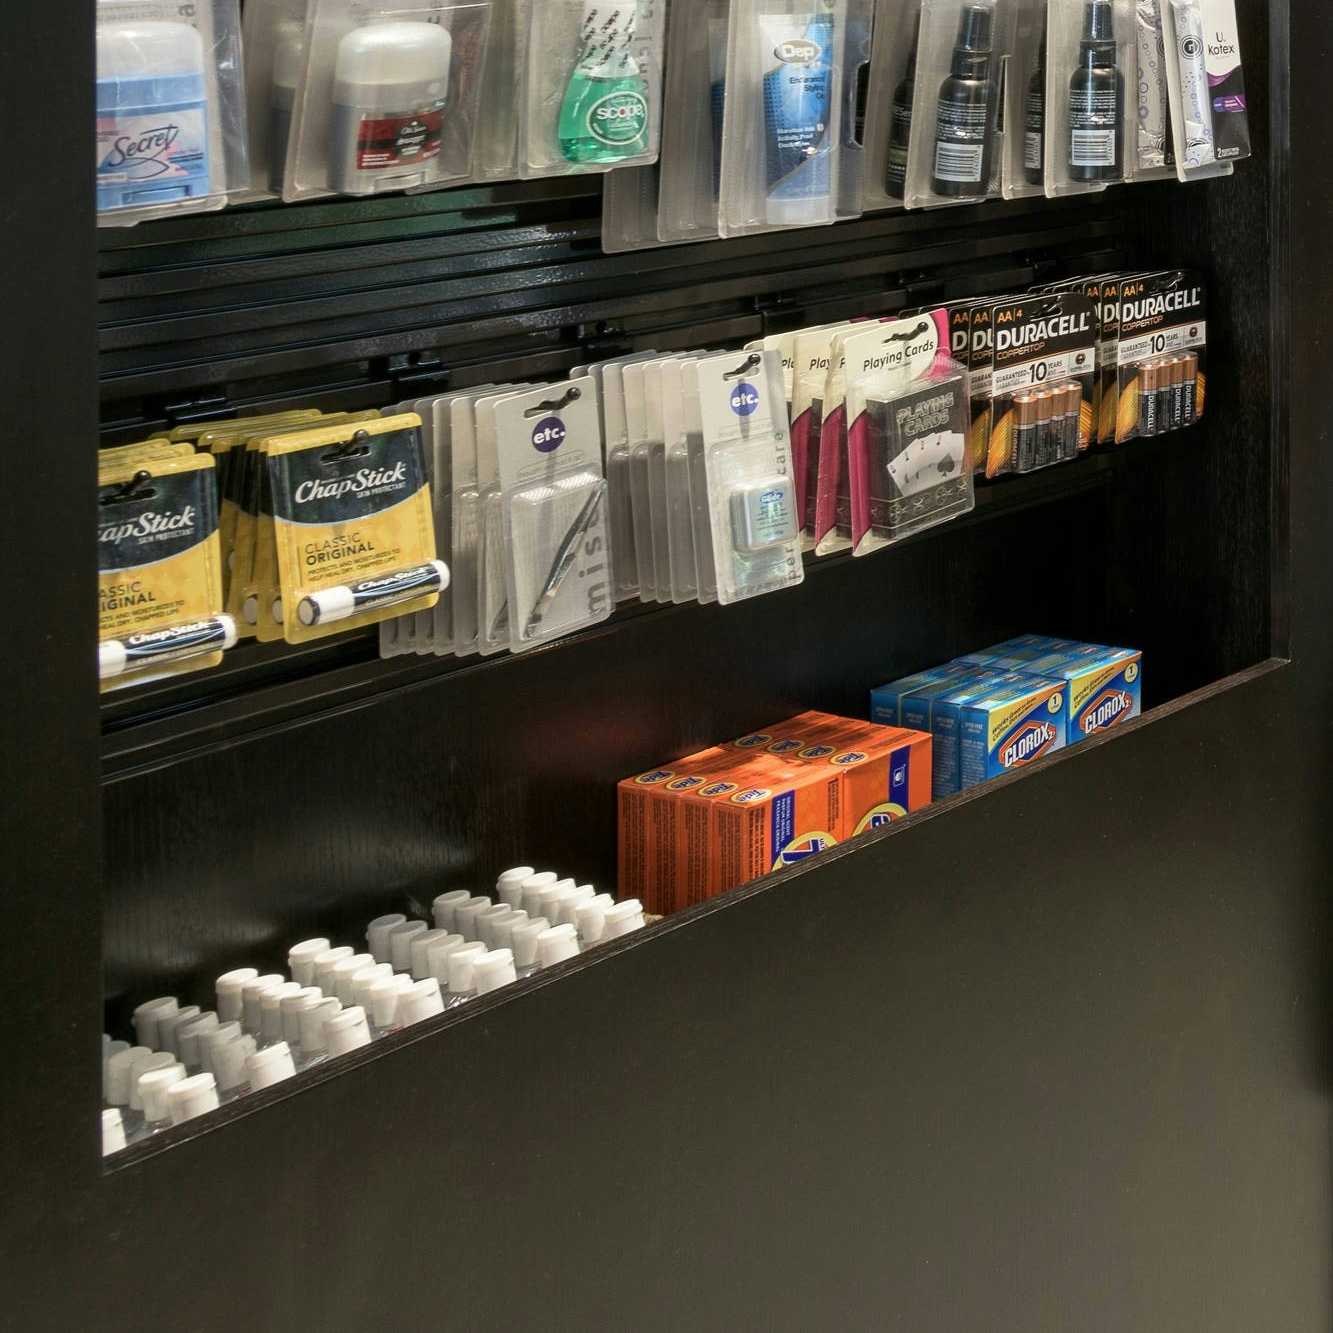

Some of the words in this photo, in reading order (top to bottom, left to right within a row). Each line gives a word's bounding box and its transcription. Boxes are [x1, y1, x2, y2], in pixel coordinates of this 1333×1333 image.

[782, 44, 815, 61] Dep
[1208, 44, 1235, 56] Kotex
[109, 123, 178, 166] Secret
[1122, 288, 1200, 323] DURACELL
[996, 312, 1090, 351] DURACELL
[1122, 316, 1164, 332] COPPERTOP
[996, 342, 1046, 360] COPPERTOP
[1150, 334, 1165, 354] 10
[863, 350, 903, 372] Playing
[904, 339, 935, 358] Cards
[1029, 362, 1047, 383] 10
[730, 392, 759, 408] etc.
[533, 428, 565, 445] etc.
[294, 462, 406, 504] ChapStick
[305, 532, 361, 555] CLASSIC
[306, 541, 375, 566] ORIGINAL
